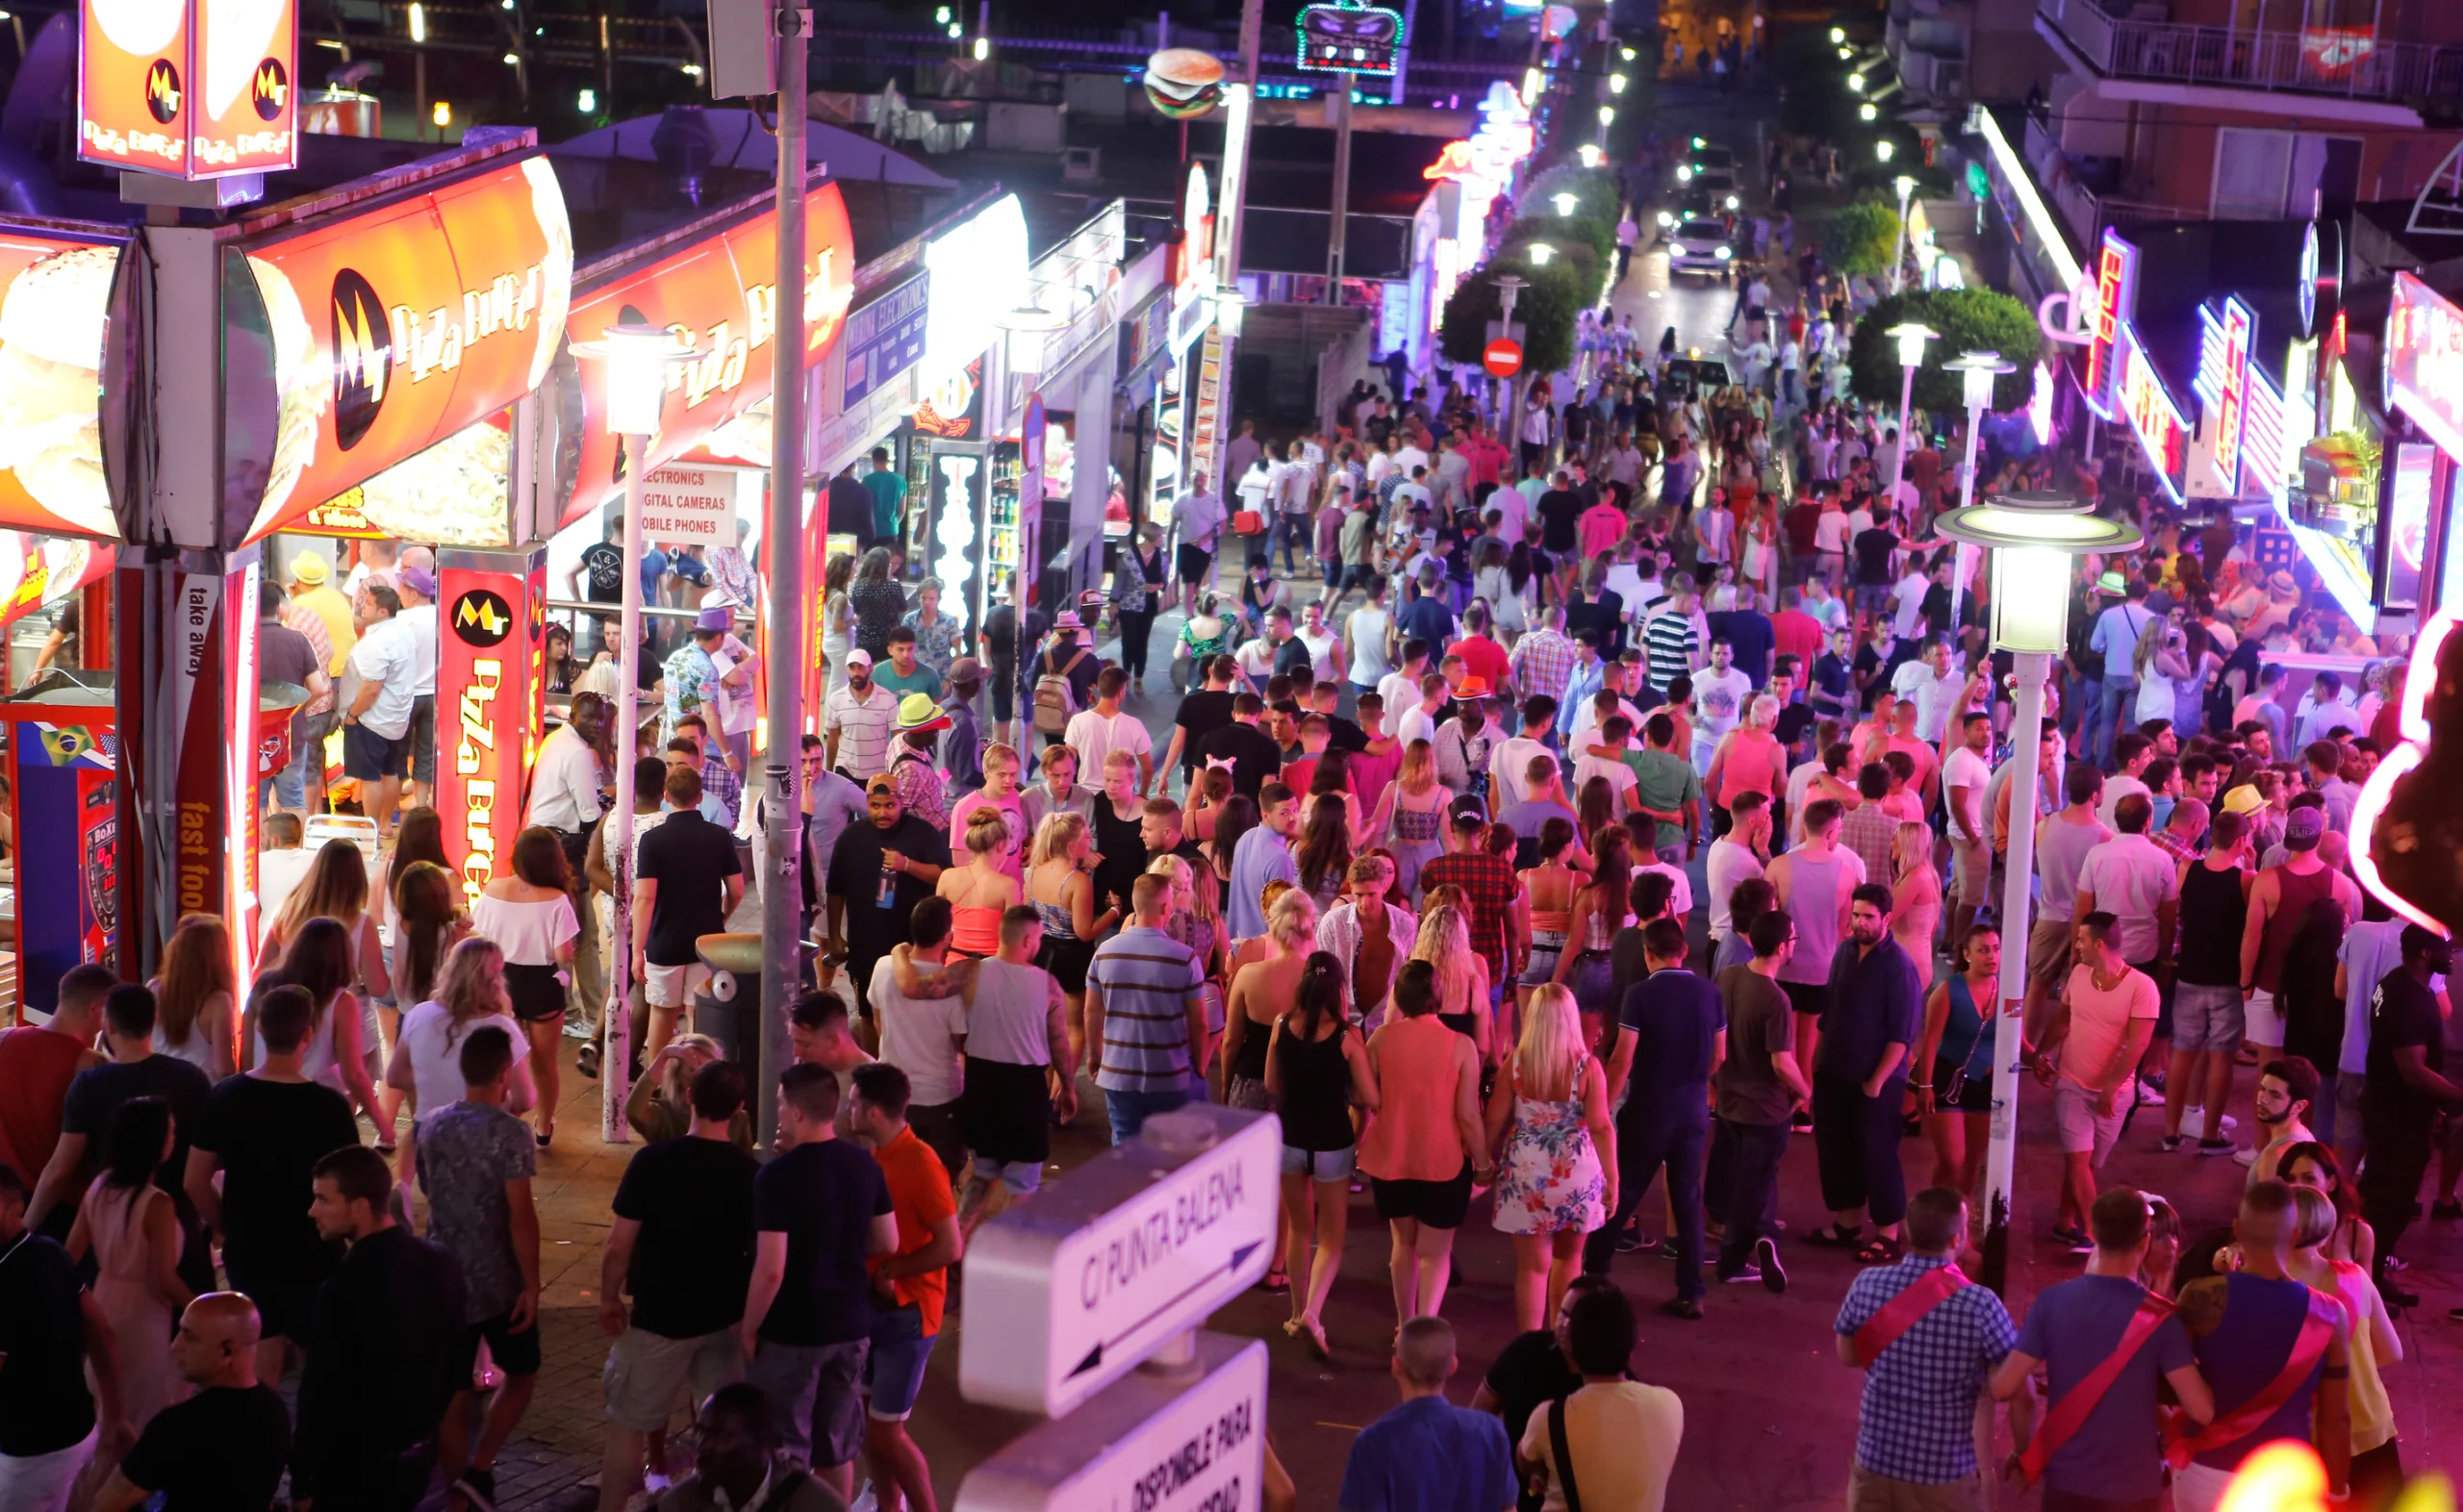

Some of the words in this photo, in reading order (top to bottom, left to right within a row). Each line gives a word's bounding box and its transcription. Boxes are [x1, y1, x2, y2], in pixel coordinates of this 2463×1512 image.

[643, 470, 705, 487] ECTRONICS
[642, 517, 672, 531] OBILE
[674, 518, 716, 534] PHONES
[676, 495, 725, 511] CAMERAS
[189, 588, 208, 626] take
[181, 802, 211, 856] fast
[180, 865, 211, 917] foo
[1106, 1206, 1173, 1295] PUNTA
[1175, 1156, 1245, 1248] BALENA
[1215, 1395, 1253, 1461] PARA
